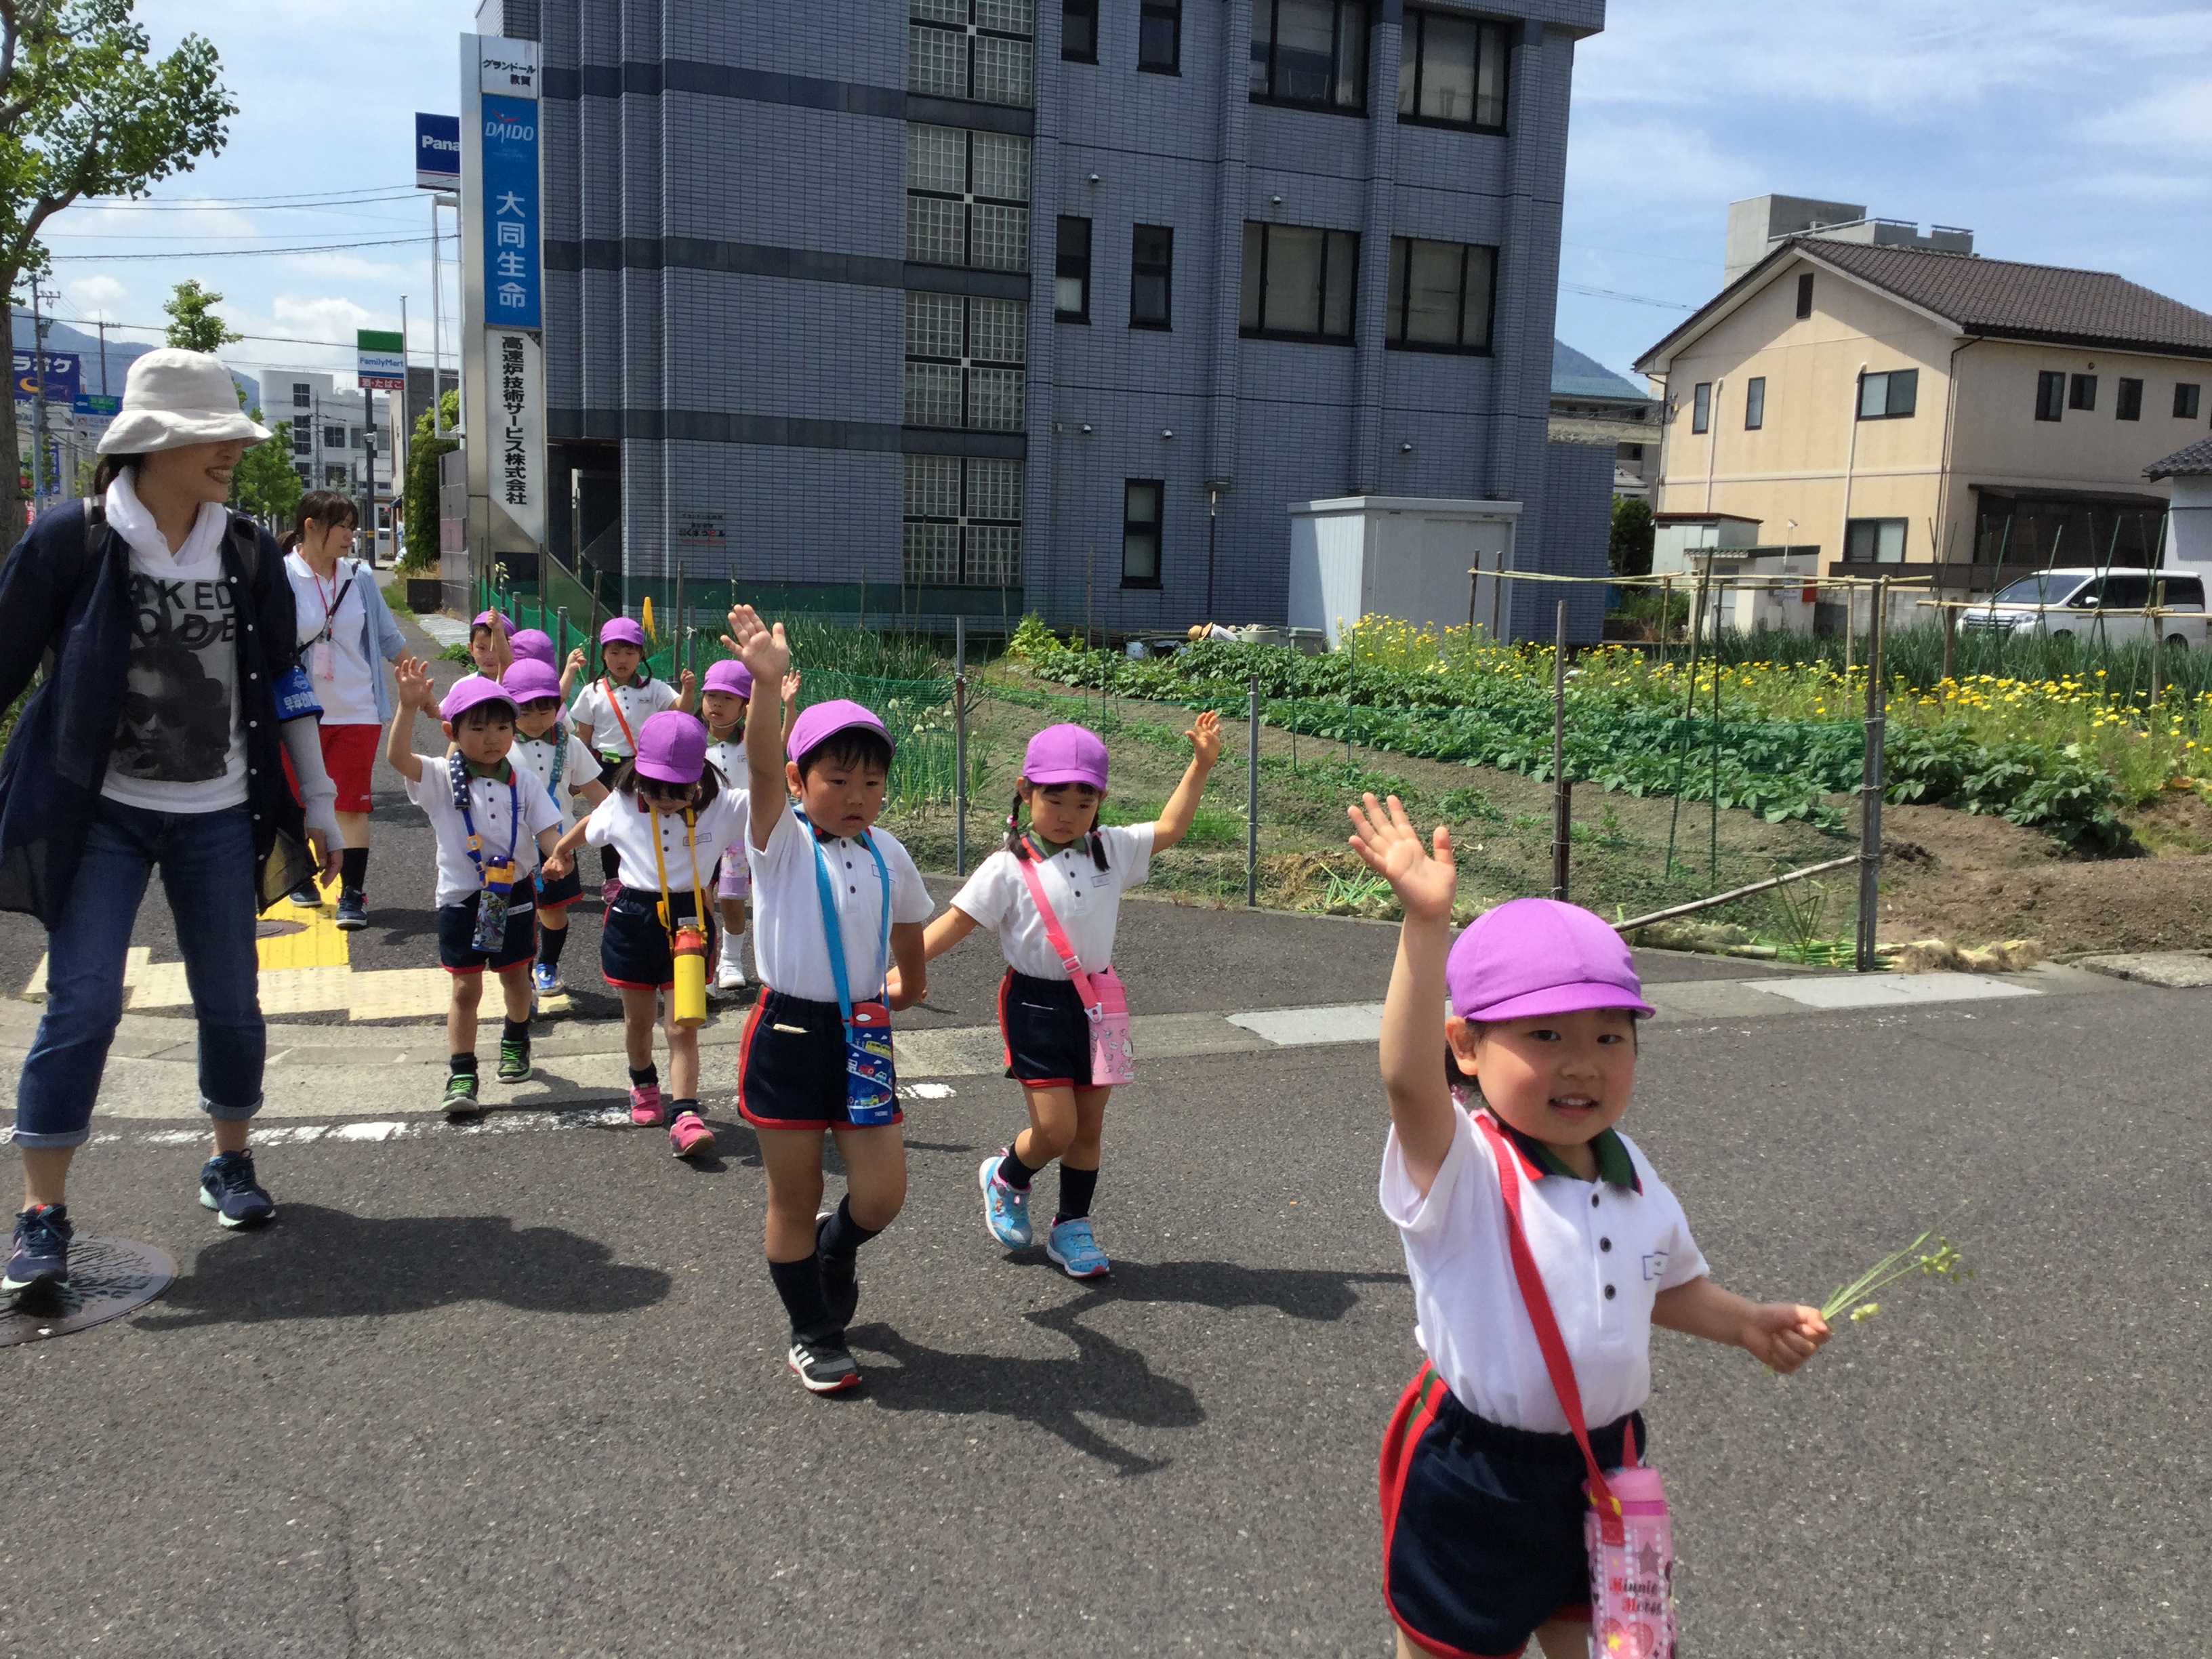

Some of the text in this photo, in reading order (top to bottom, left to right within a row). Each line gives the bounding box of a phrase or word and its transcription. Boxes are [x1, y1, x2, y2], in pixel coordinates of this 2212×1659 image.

[483, 59, 536, 74] グランドール
[485, 121, 534, 144] DAIDO
[422, 135, 459, 151] Pana
[496, 190, 527, 309] 大同生命
[359, 356, 404, 367] FamilyMart
[502, 336, 527, 505] 高速炉技術サービス株式会社
